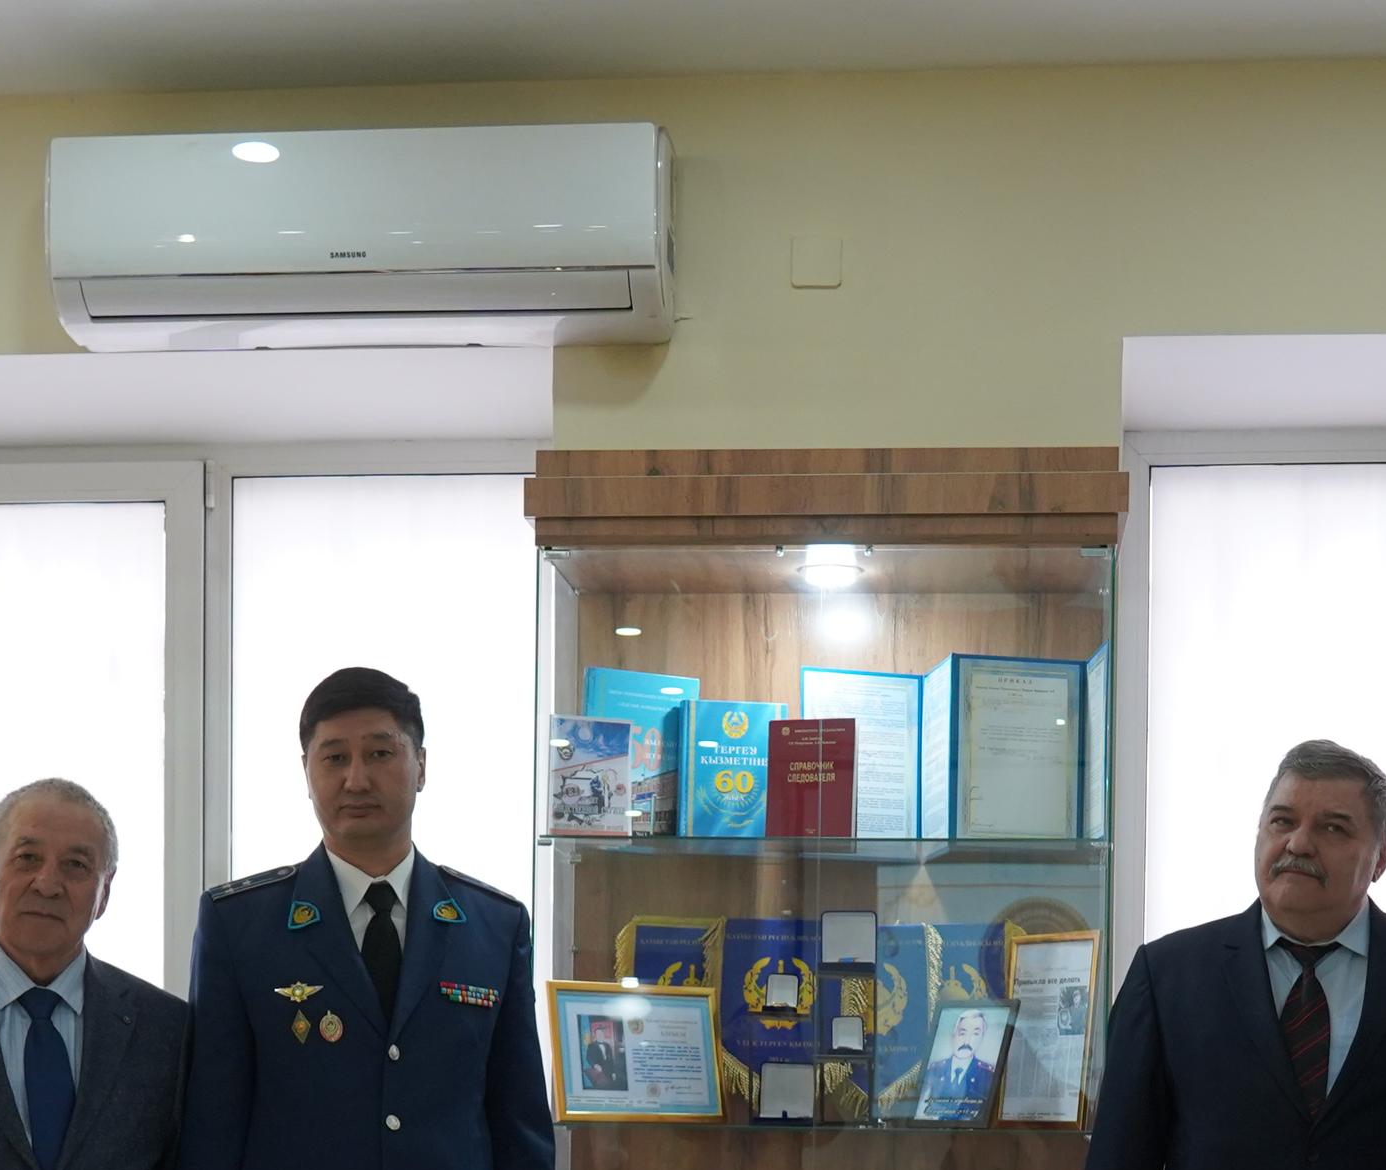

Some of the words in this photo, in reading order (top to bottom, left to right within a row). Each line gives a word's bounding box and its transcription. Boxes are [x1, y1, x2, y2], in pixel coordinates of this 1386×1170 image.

[330, 251, 367, 259] SAMSUNG
[789, 760, 834, 771] СПРАВОЧНИК
[715, 770, 754, 793] 60
[787, 773, 836, 783] СЛЕДОВАТЕЛЯ
